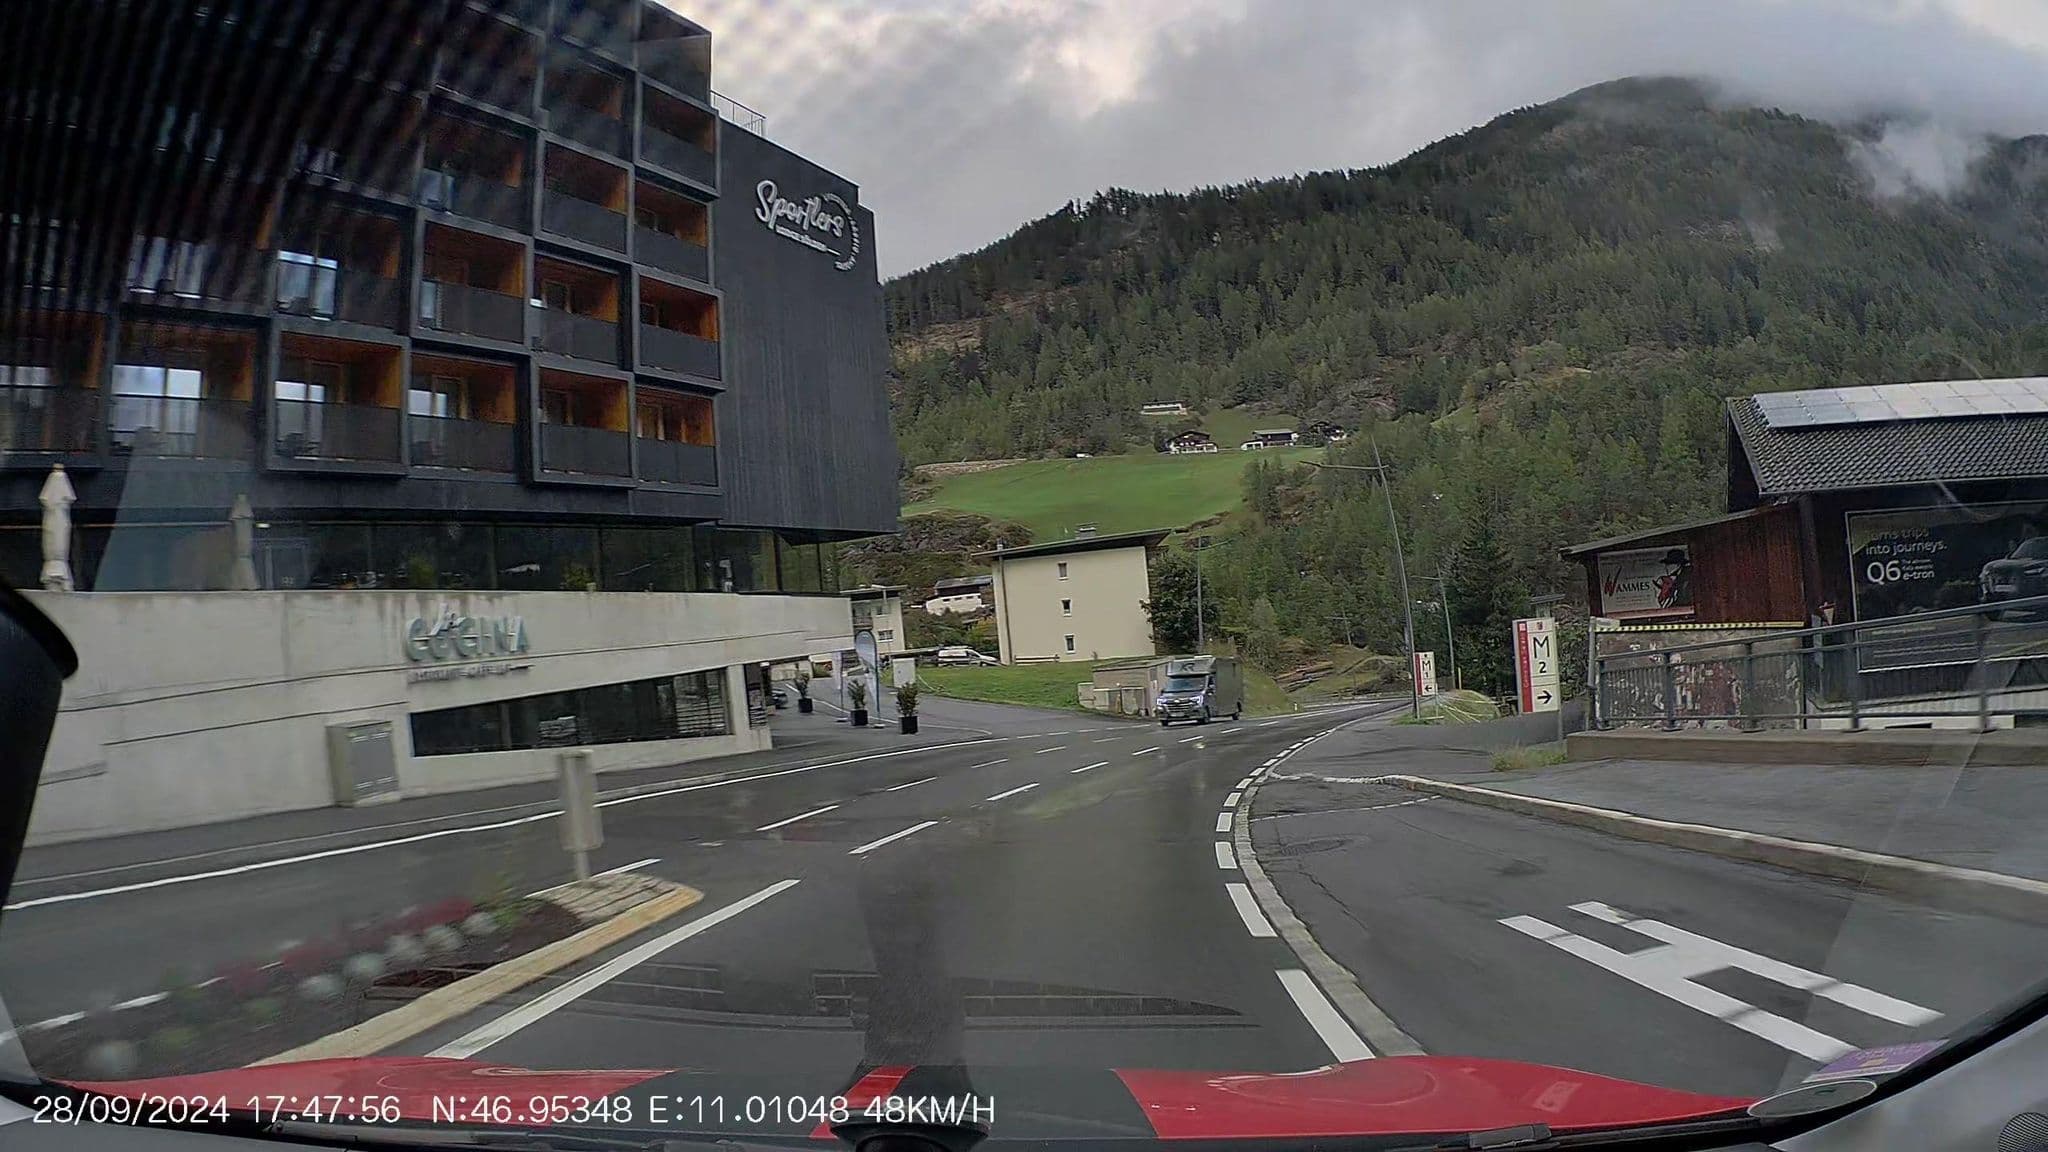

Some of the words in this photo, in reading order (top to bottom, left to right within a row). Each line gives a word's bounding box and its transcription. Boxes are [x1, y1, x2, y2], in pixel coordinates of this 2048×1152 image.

[1866, 544, 1892, 556] into
[1893, 541, 1948, 556] journeys.
[1866, 560, 1902, 585] Q6
[1532, 635, 1550, 659] M
[1422, 660, 1432, 671] M
[1538, 661, 1547, 674] 2
